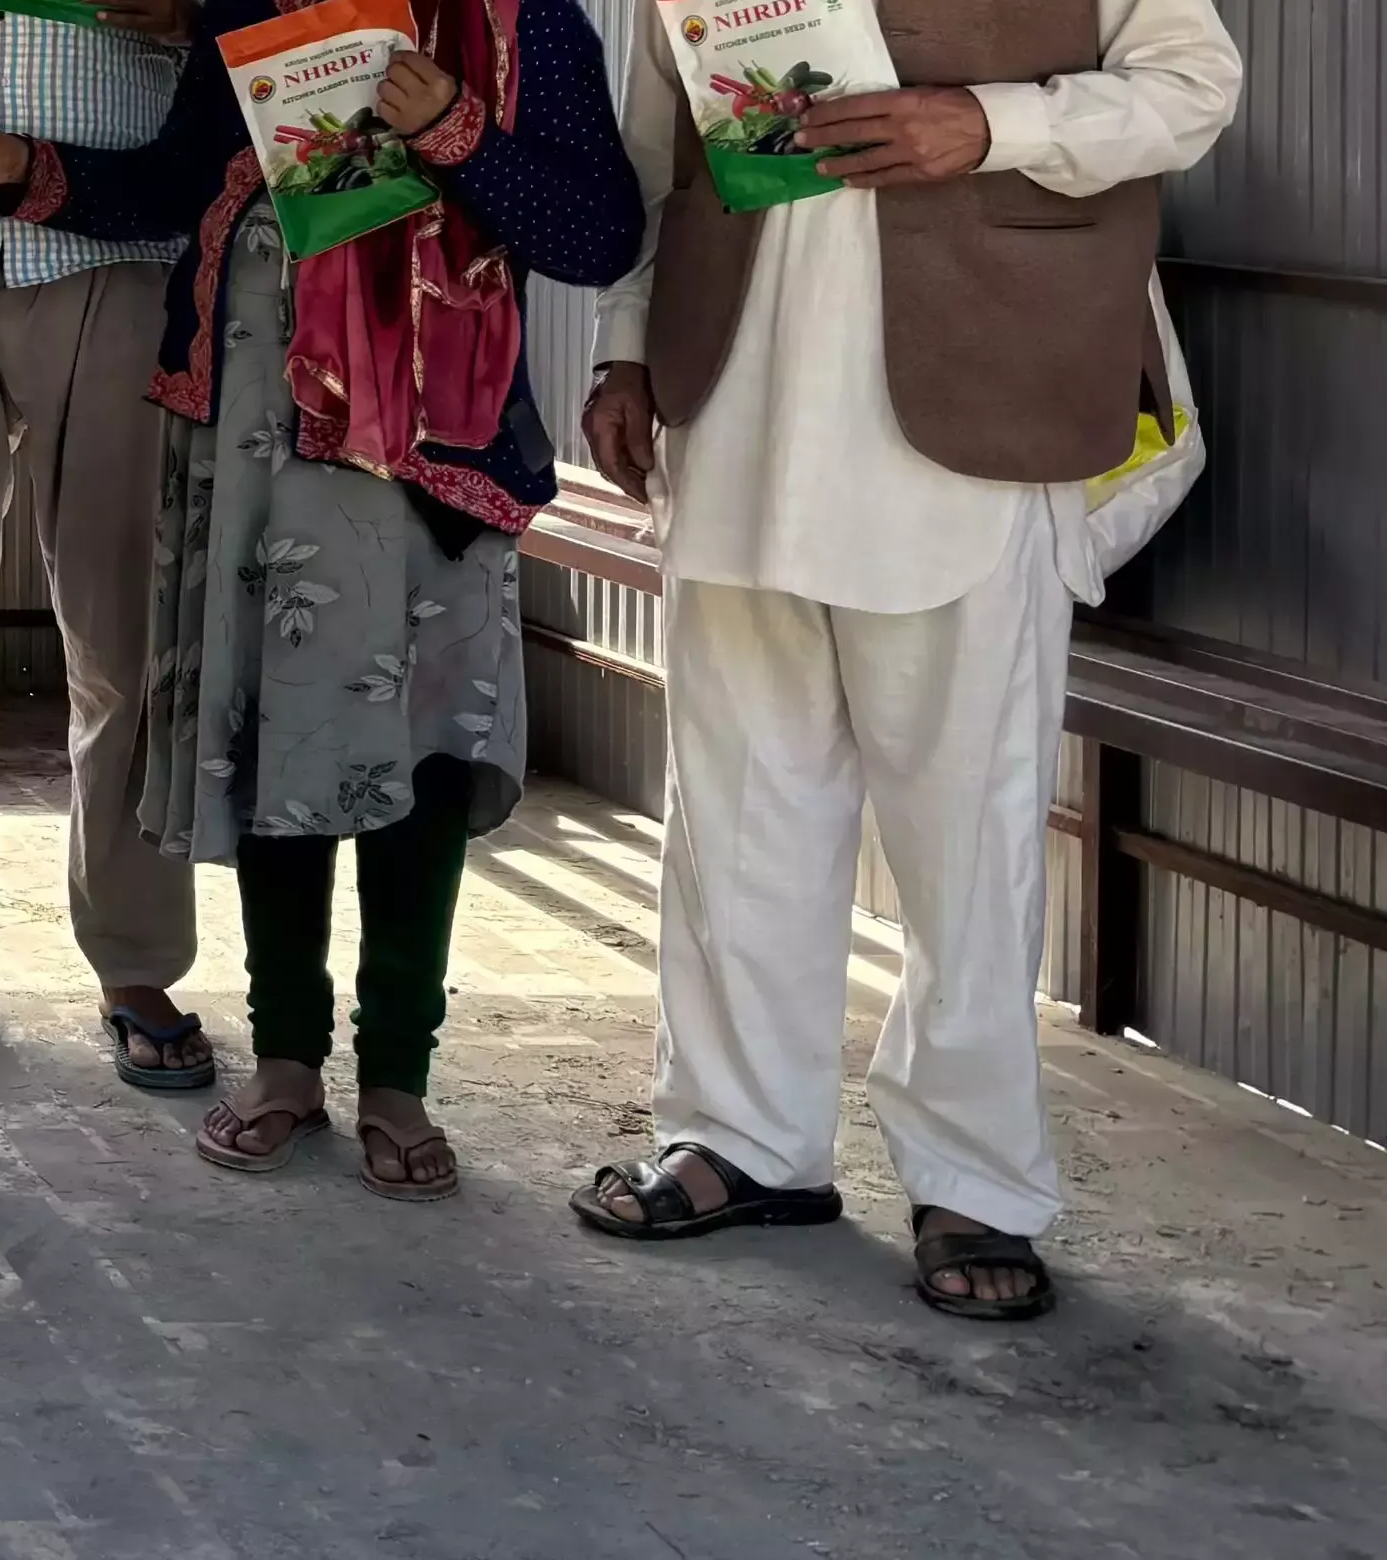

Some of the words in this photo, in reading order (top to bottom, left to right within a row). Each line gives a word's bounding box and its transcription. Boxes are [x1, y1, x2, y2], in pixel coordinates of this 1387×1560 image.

[714, 38, 747, 51] KITCHEN
[749, 29, 782, 42] GARDEN
[785, 23, 805, 34] SEED
[808, 19, 822, 29] KIT
[283, 49, 373, 88] NHRDF
